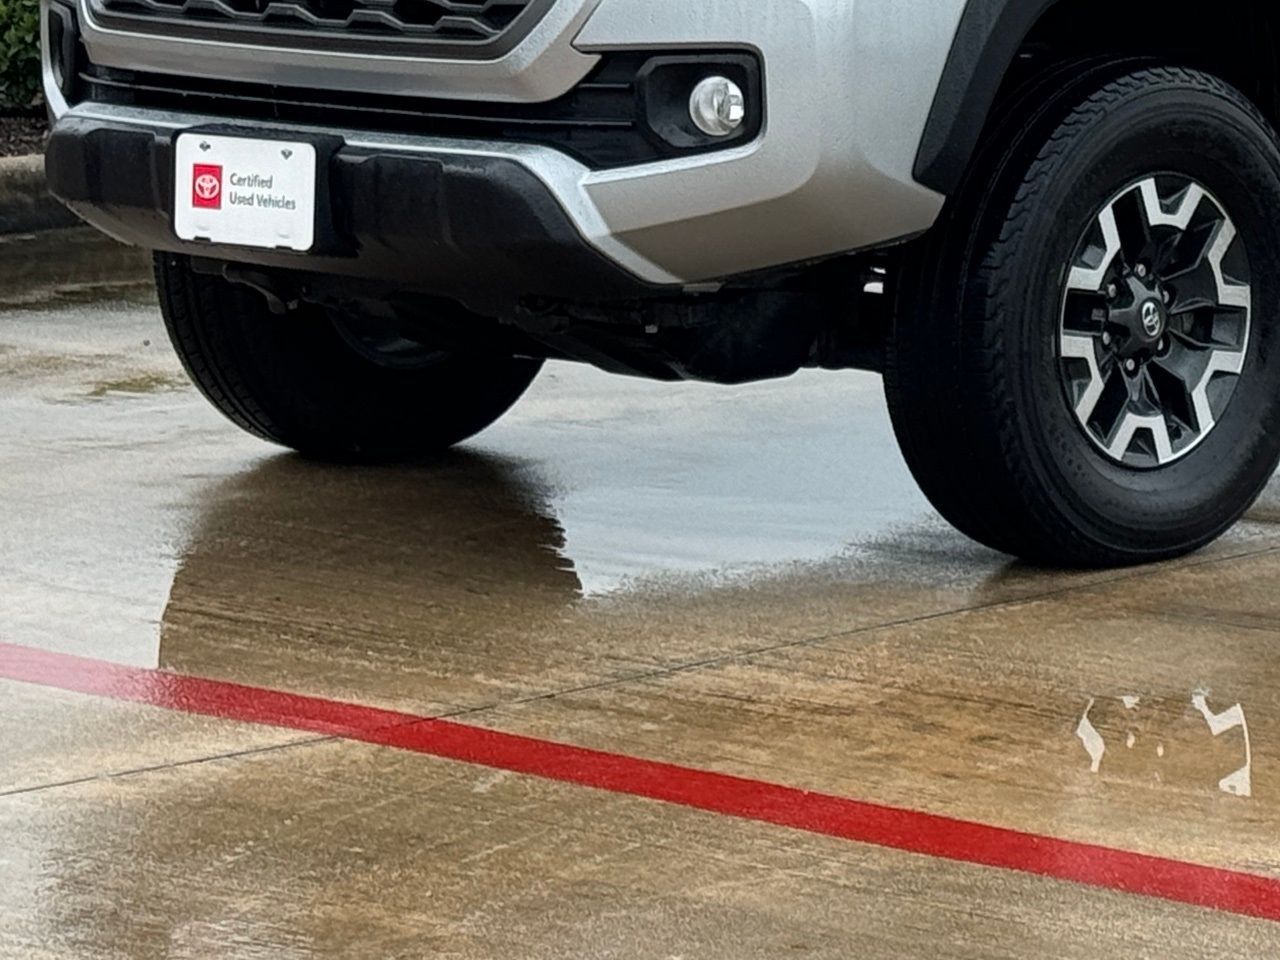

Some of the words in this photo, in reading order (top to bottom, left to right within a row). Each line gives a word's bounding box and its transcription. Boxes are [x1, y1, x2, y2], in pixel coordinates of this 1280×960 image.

[230, 173, 273, 189] Certified
[230, 192, 254, 207] Used
[256, 194, 296, 210] Vehicles
